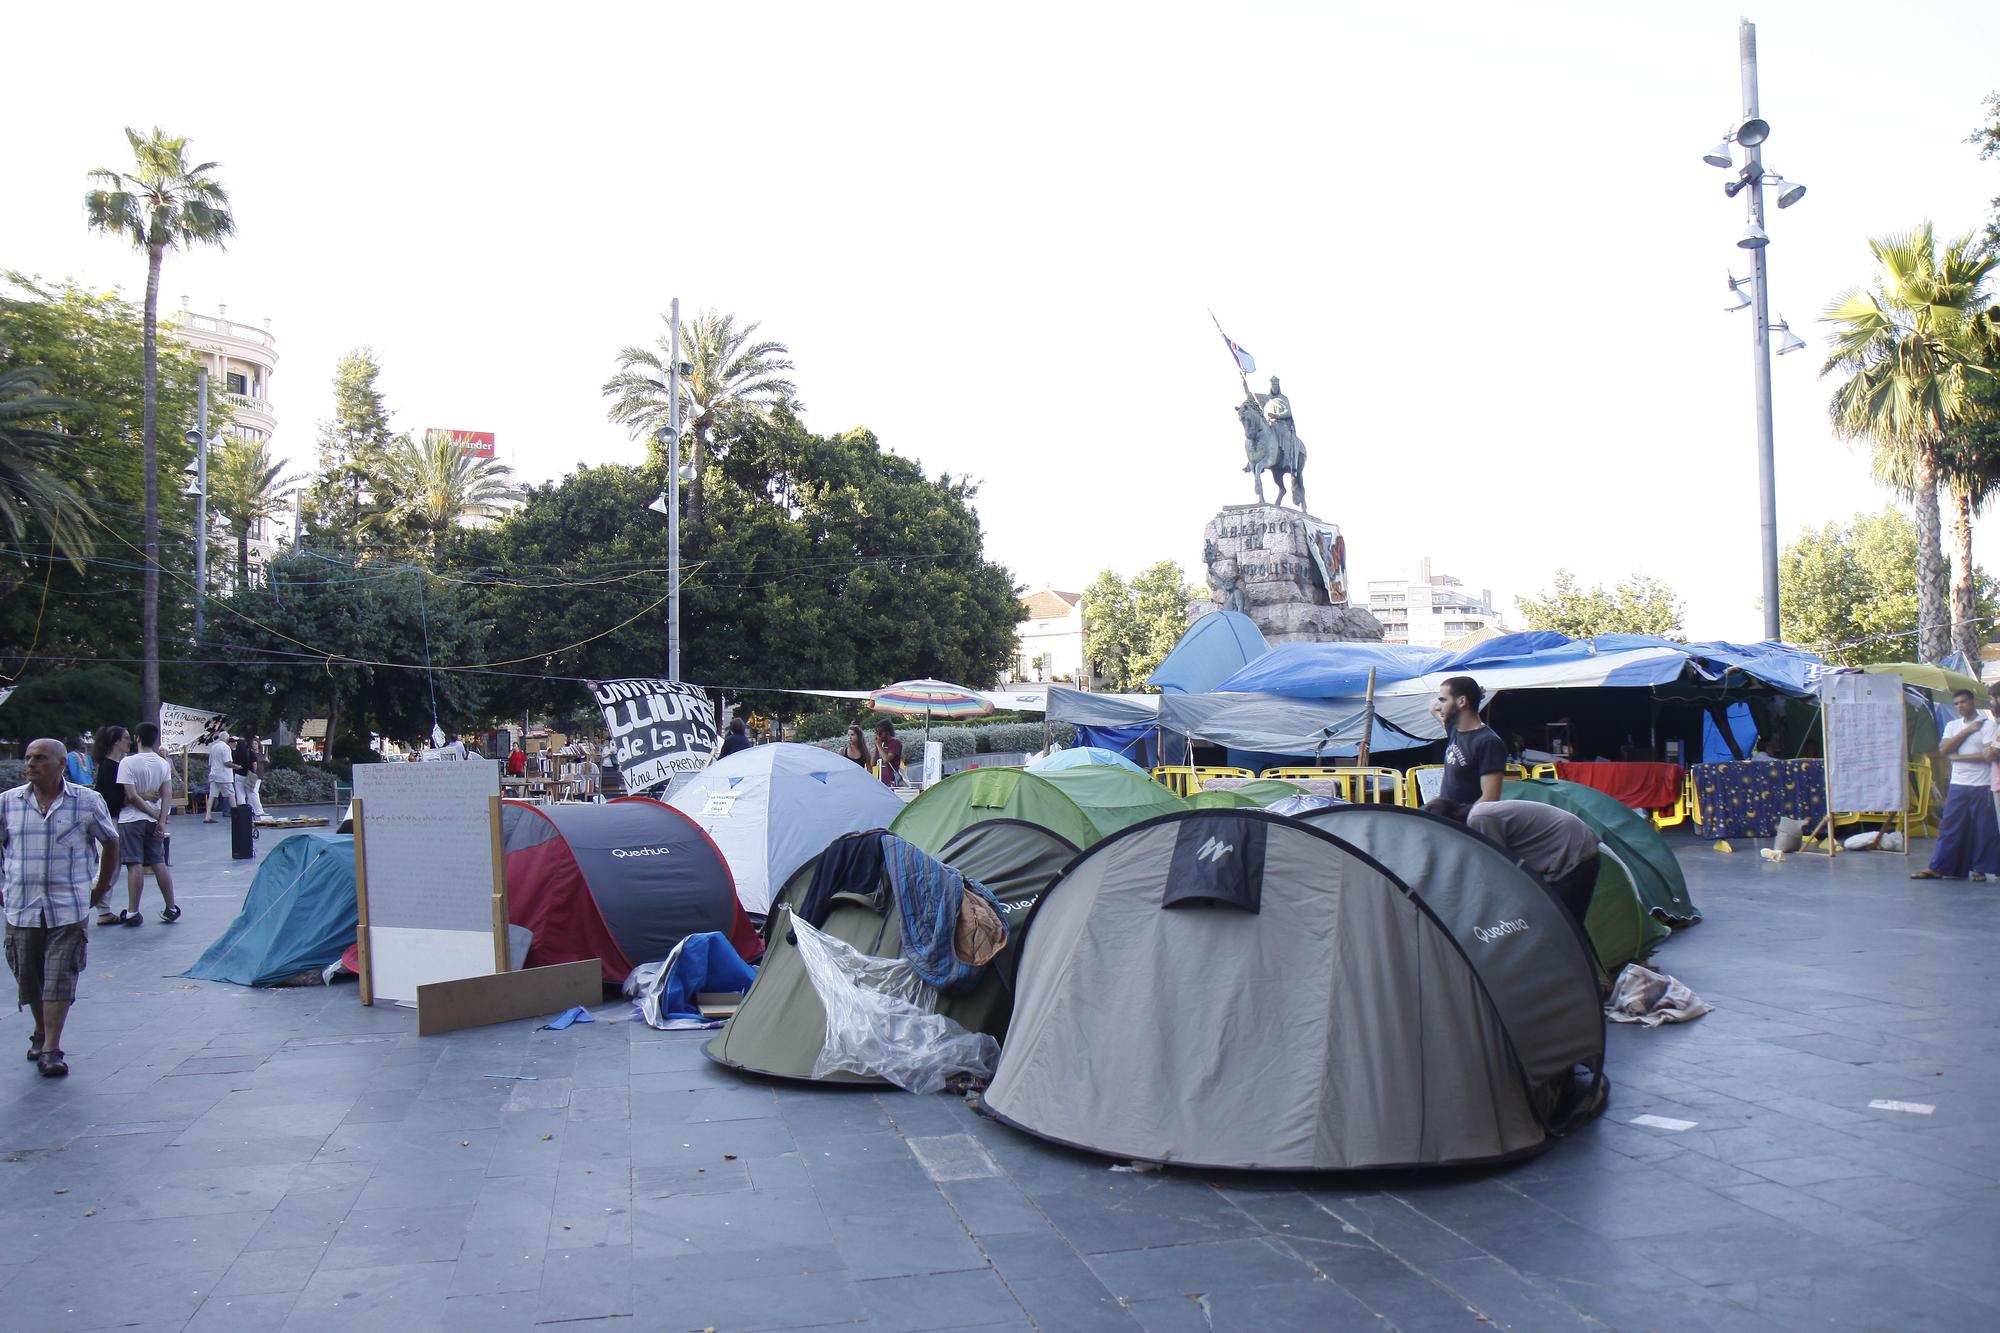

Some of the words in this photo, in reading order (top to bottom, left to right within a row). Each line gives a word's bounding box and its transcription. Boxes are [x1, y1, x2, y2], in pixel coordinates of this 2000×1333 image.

[163, 719, 173, 727] NO
[164, 711, 207, 724] CAPITALISMO
[605, 693, 717, 737] LLiURE
[617, 736, 645, 762] de
[624, 768, 655, 789] Vine
[612, 847, 670, 859] Quechua
[1473, 918, 1529, 944] Quechua
